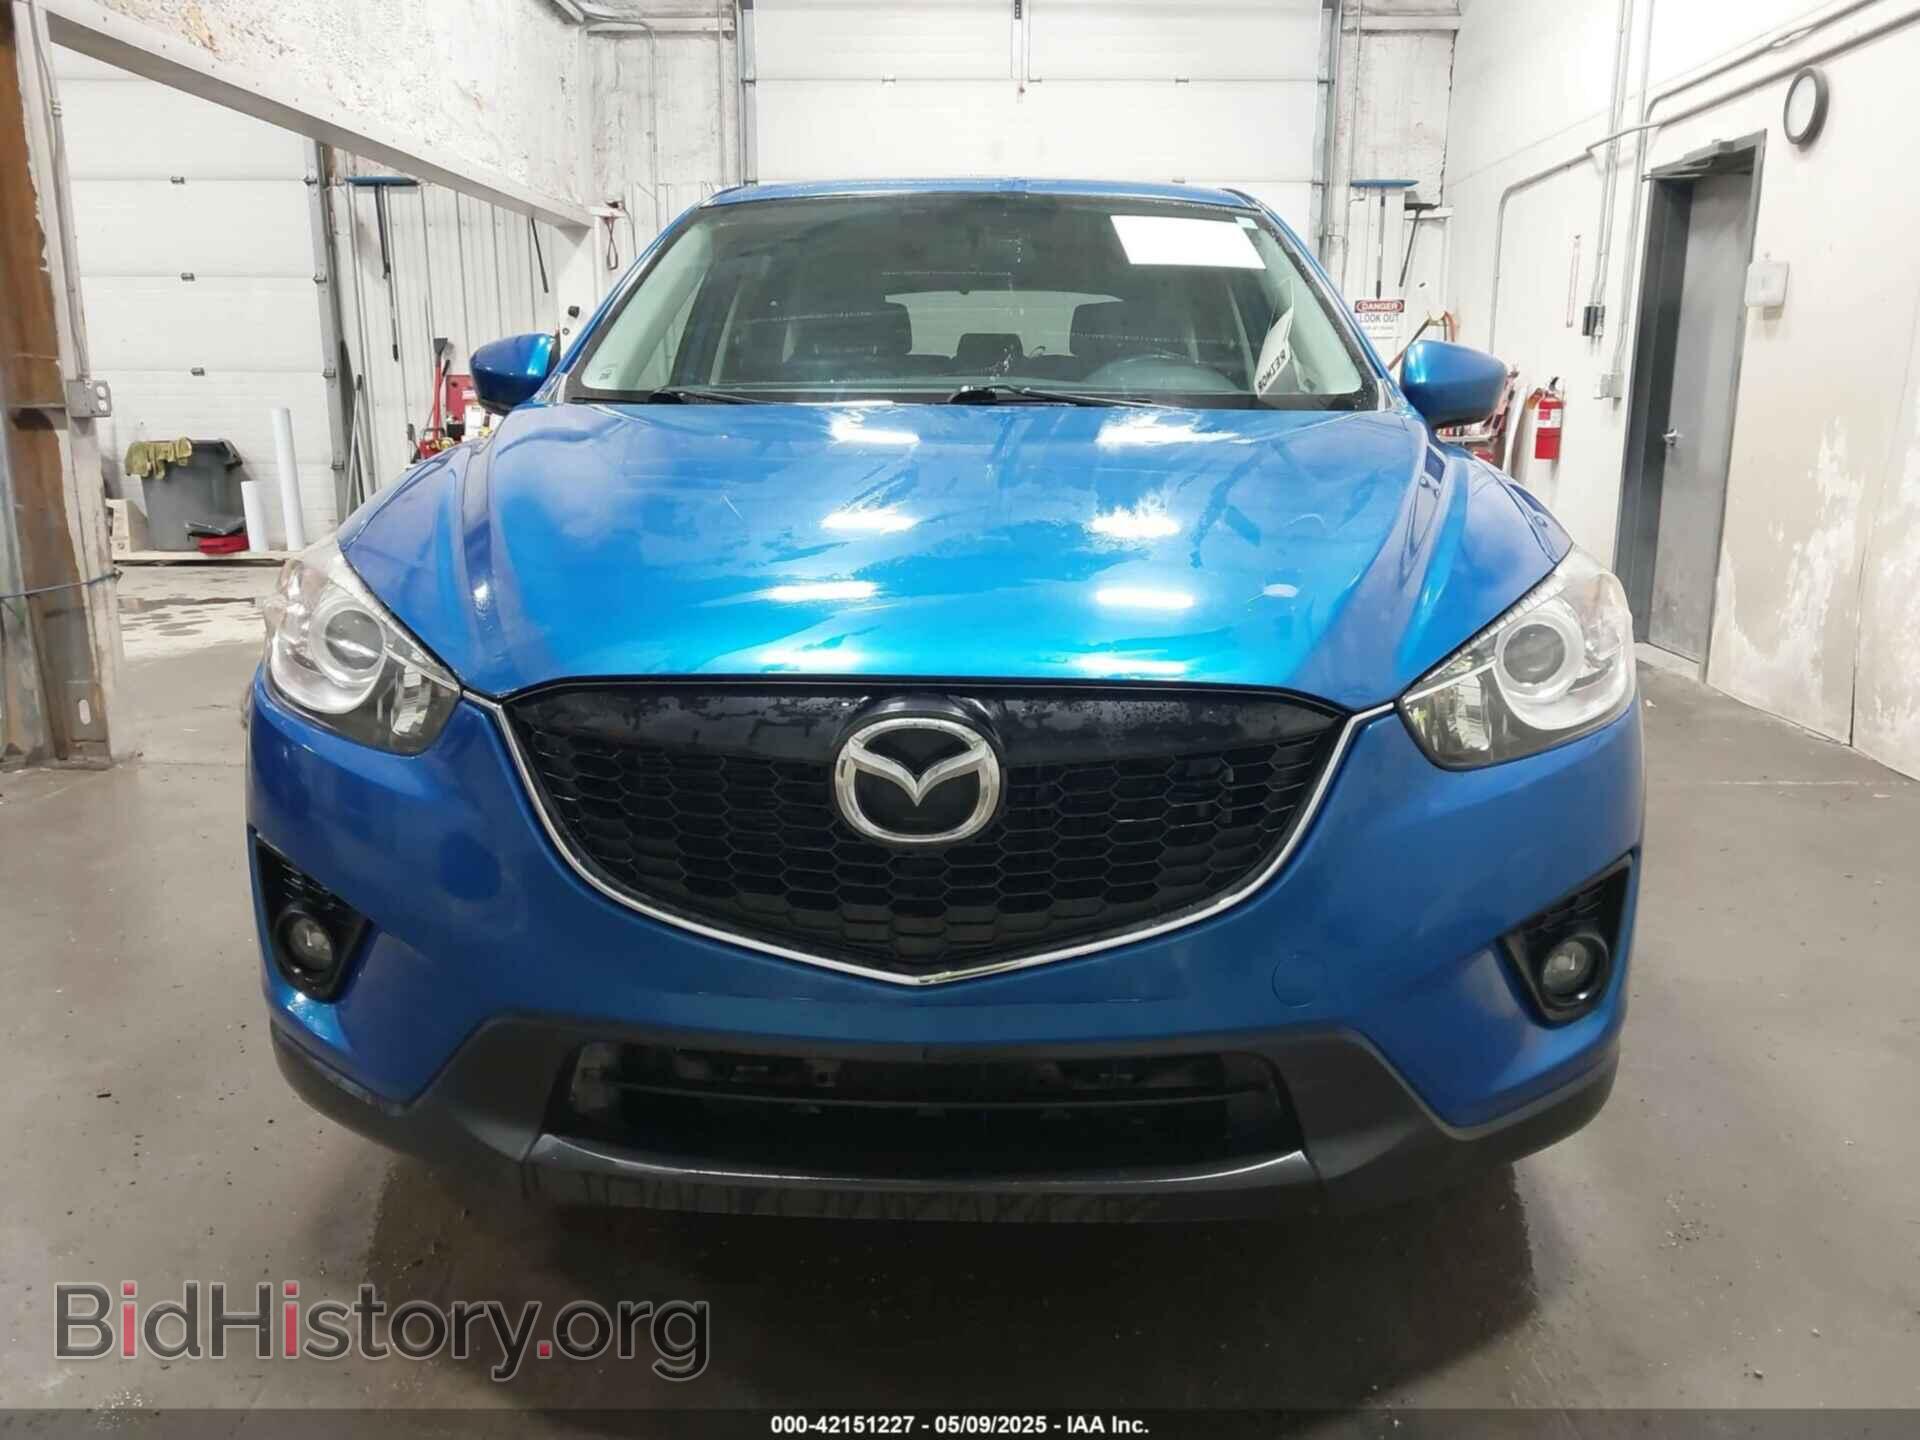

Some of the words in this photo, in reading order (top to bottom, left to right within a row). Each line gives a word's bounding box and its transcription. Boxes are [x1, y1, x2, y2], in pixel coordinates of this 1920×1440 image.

[1361, 302, 1398, 311] DANGER
[1360, 313, 1381, 322] LOOK
[1384, 313, 1399, 322] OUT
